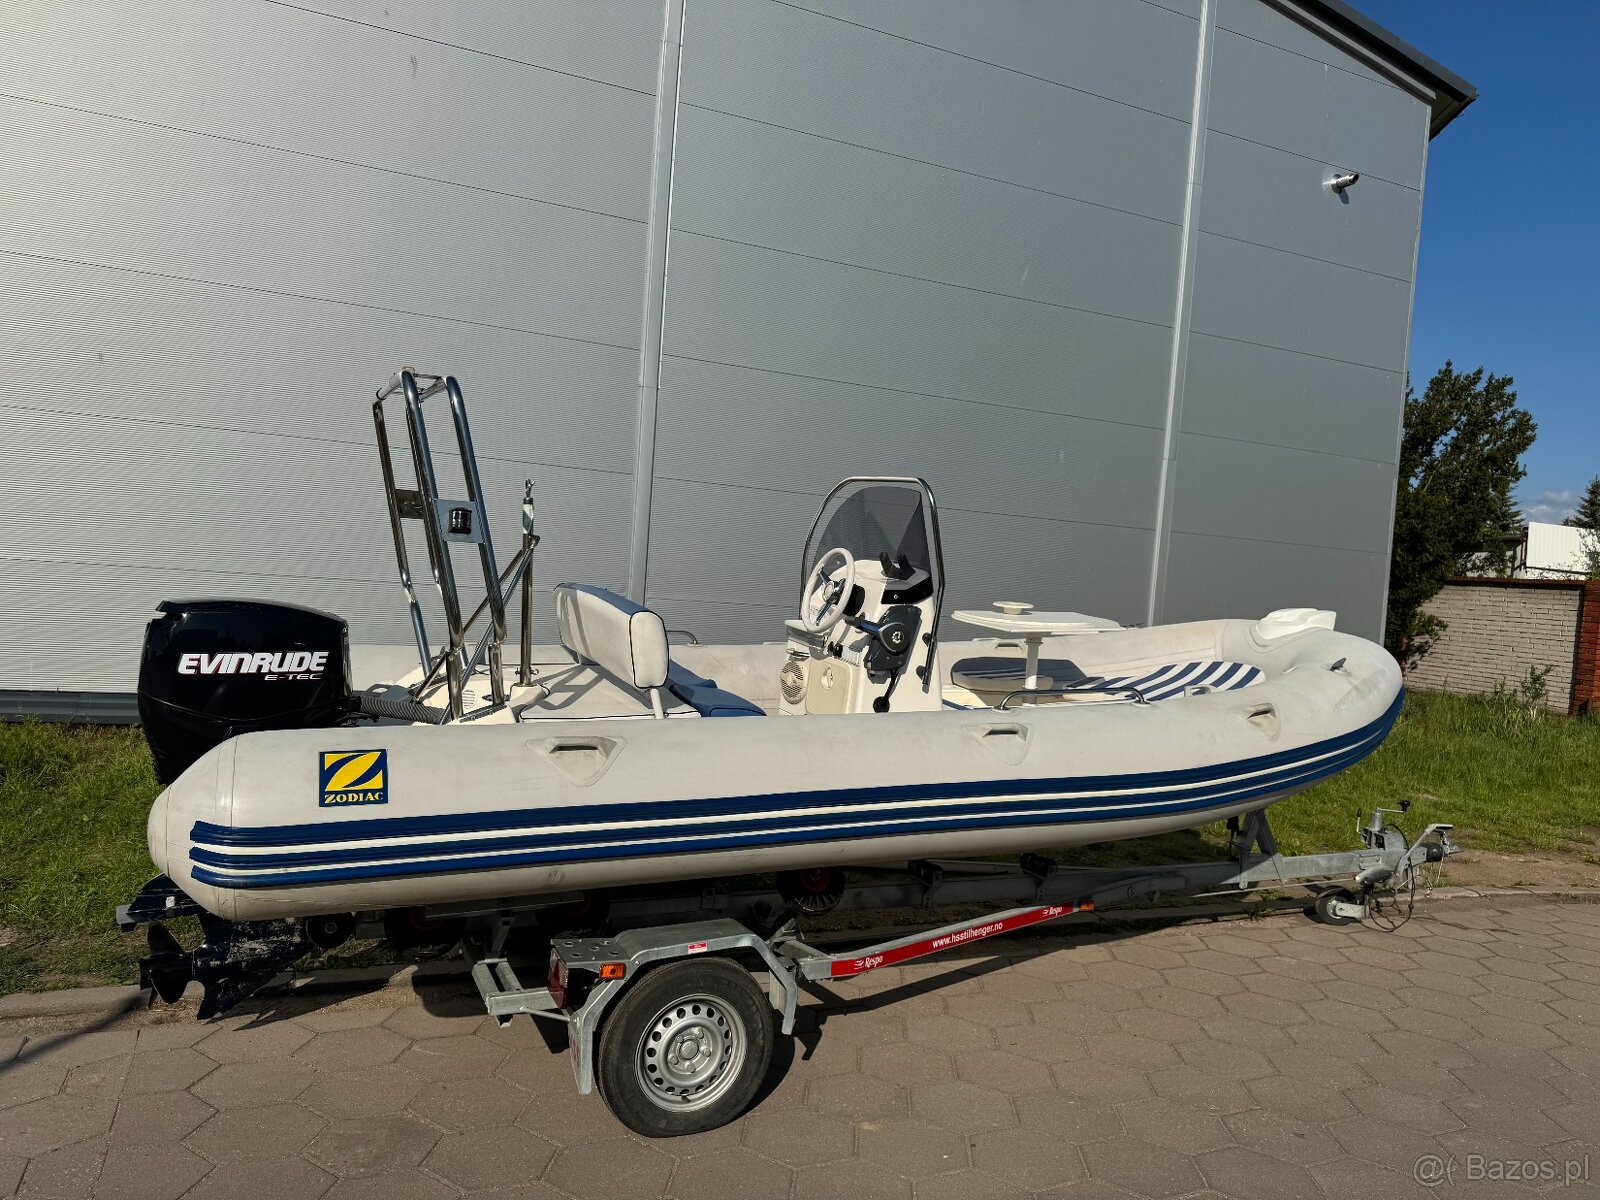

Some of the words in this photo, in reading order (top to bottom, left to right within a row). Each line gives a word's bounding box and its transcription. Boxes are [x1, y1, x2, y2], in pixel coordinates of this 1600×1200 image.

[177, 651, 329, 674] EVINRUDE
[264, 672, 322, 681] E-TEC
[324, 792, 384, 804] ZODIAC
[932, 922, 1003, 949] www.hsstilhenger.no
[864, 955, 884, 968] Respo
